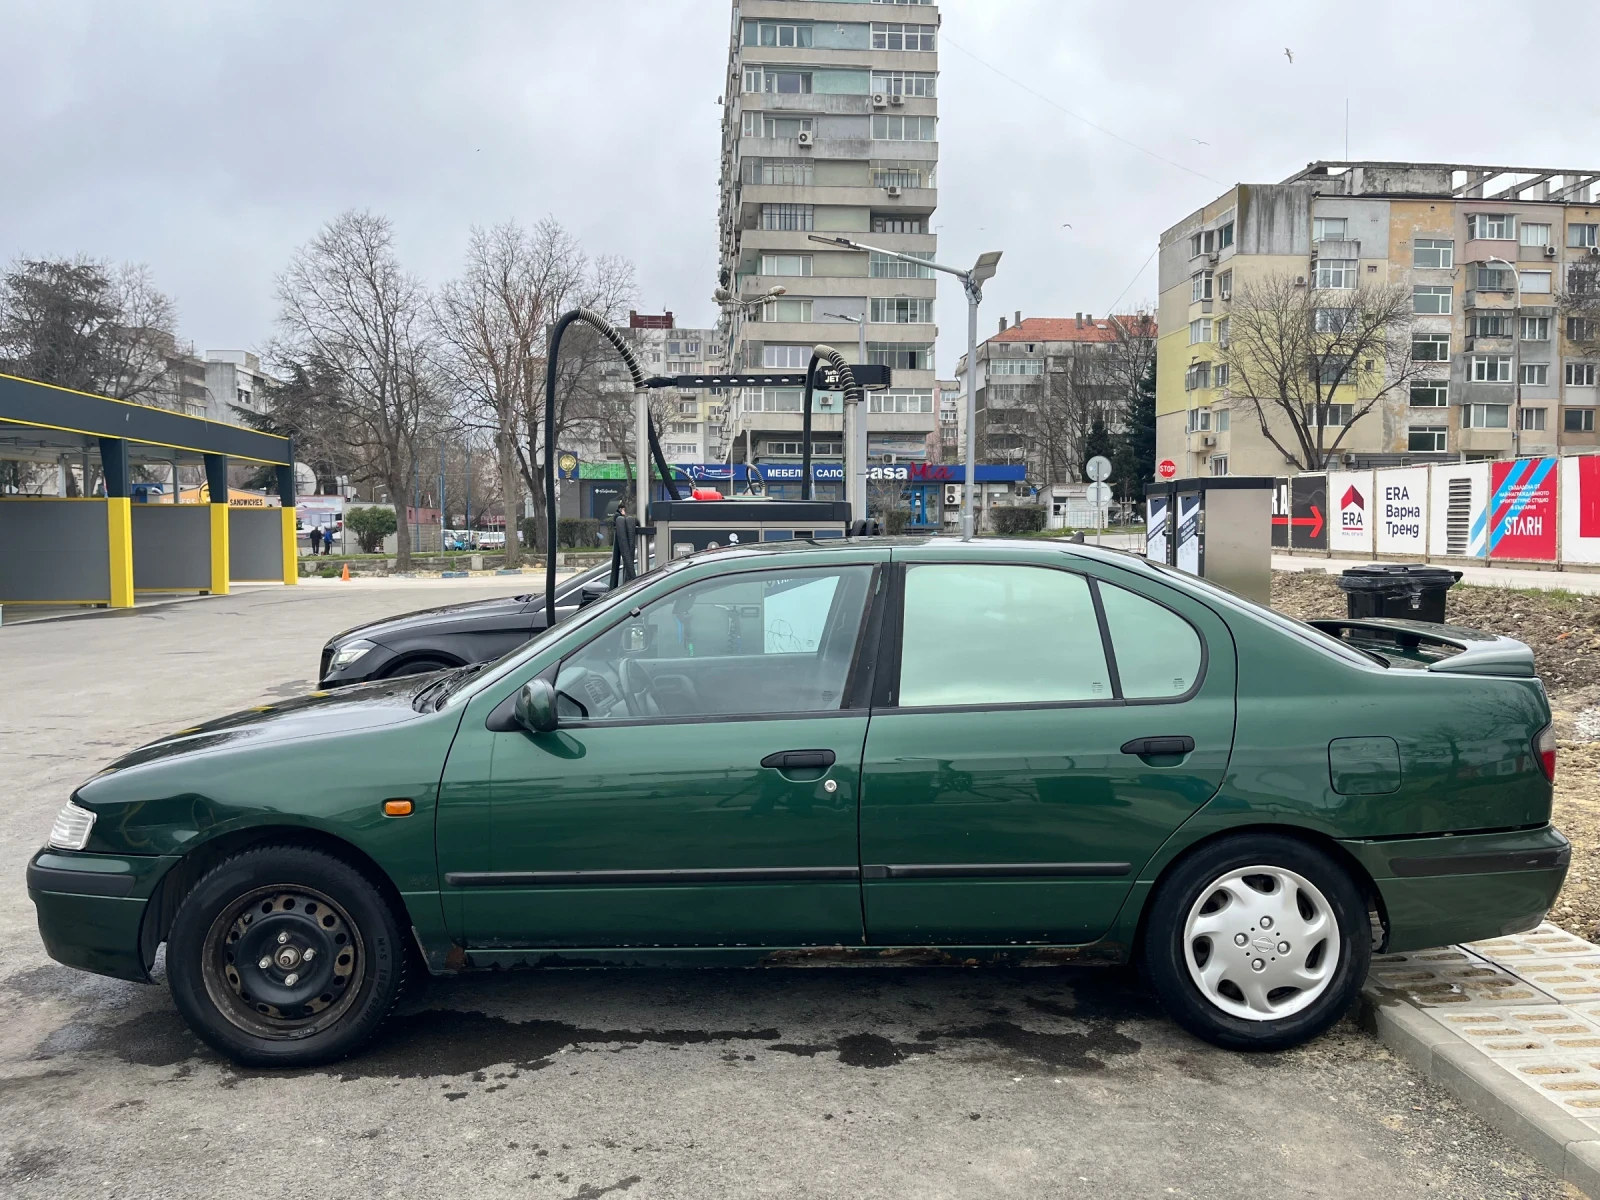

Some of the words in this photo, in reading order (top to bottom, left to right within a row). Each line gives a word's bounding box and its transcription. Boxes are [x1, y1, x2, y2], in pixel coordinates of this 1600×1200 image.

[816, 468, 844, 478] САЛО
[909, 461, 955, 480] Mia
[1160, 465, 1175, 473] STOP
[1271, 484, 1289, 515] RA
[1386, 487, 1409, 501] ERA
[229, 498, 263, 506] SANDWICHES
[1342, 512, 1364, 526] ERA
[1386, 504, 1421, 520] Варна
